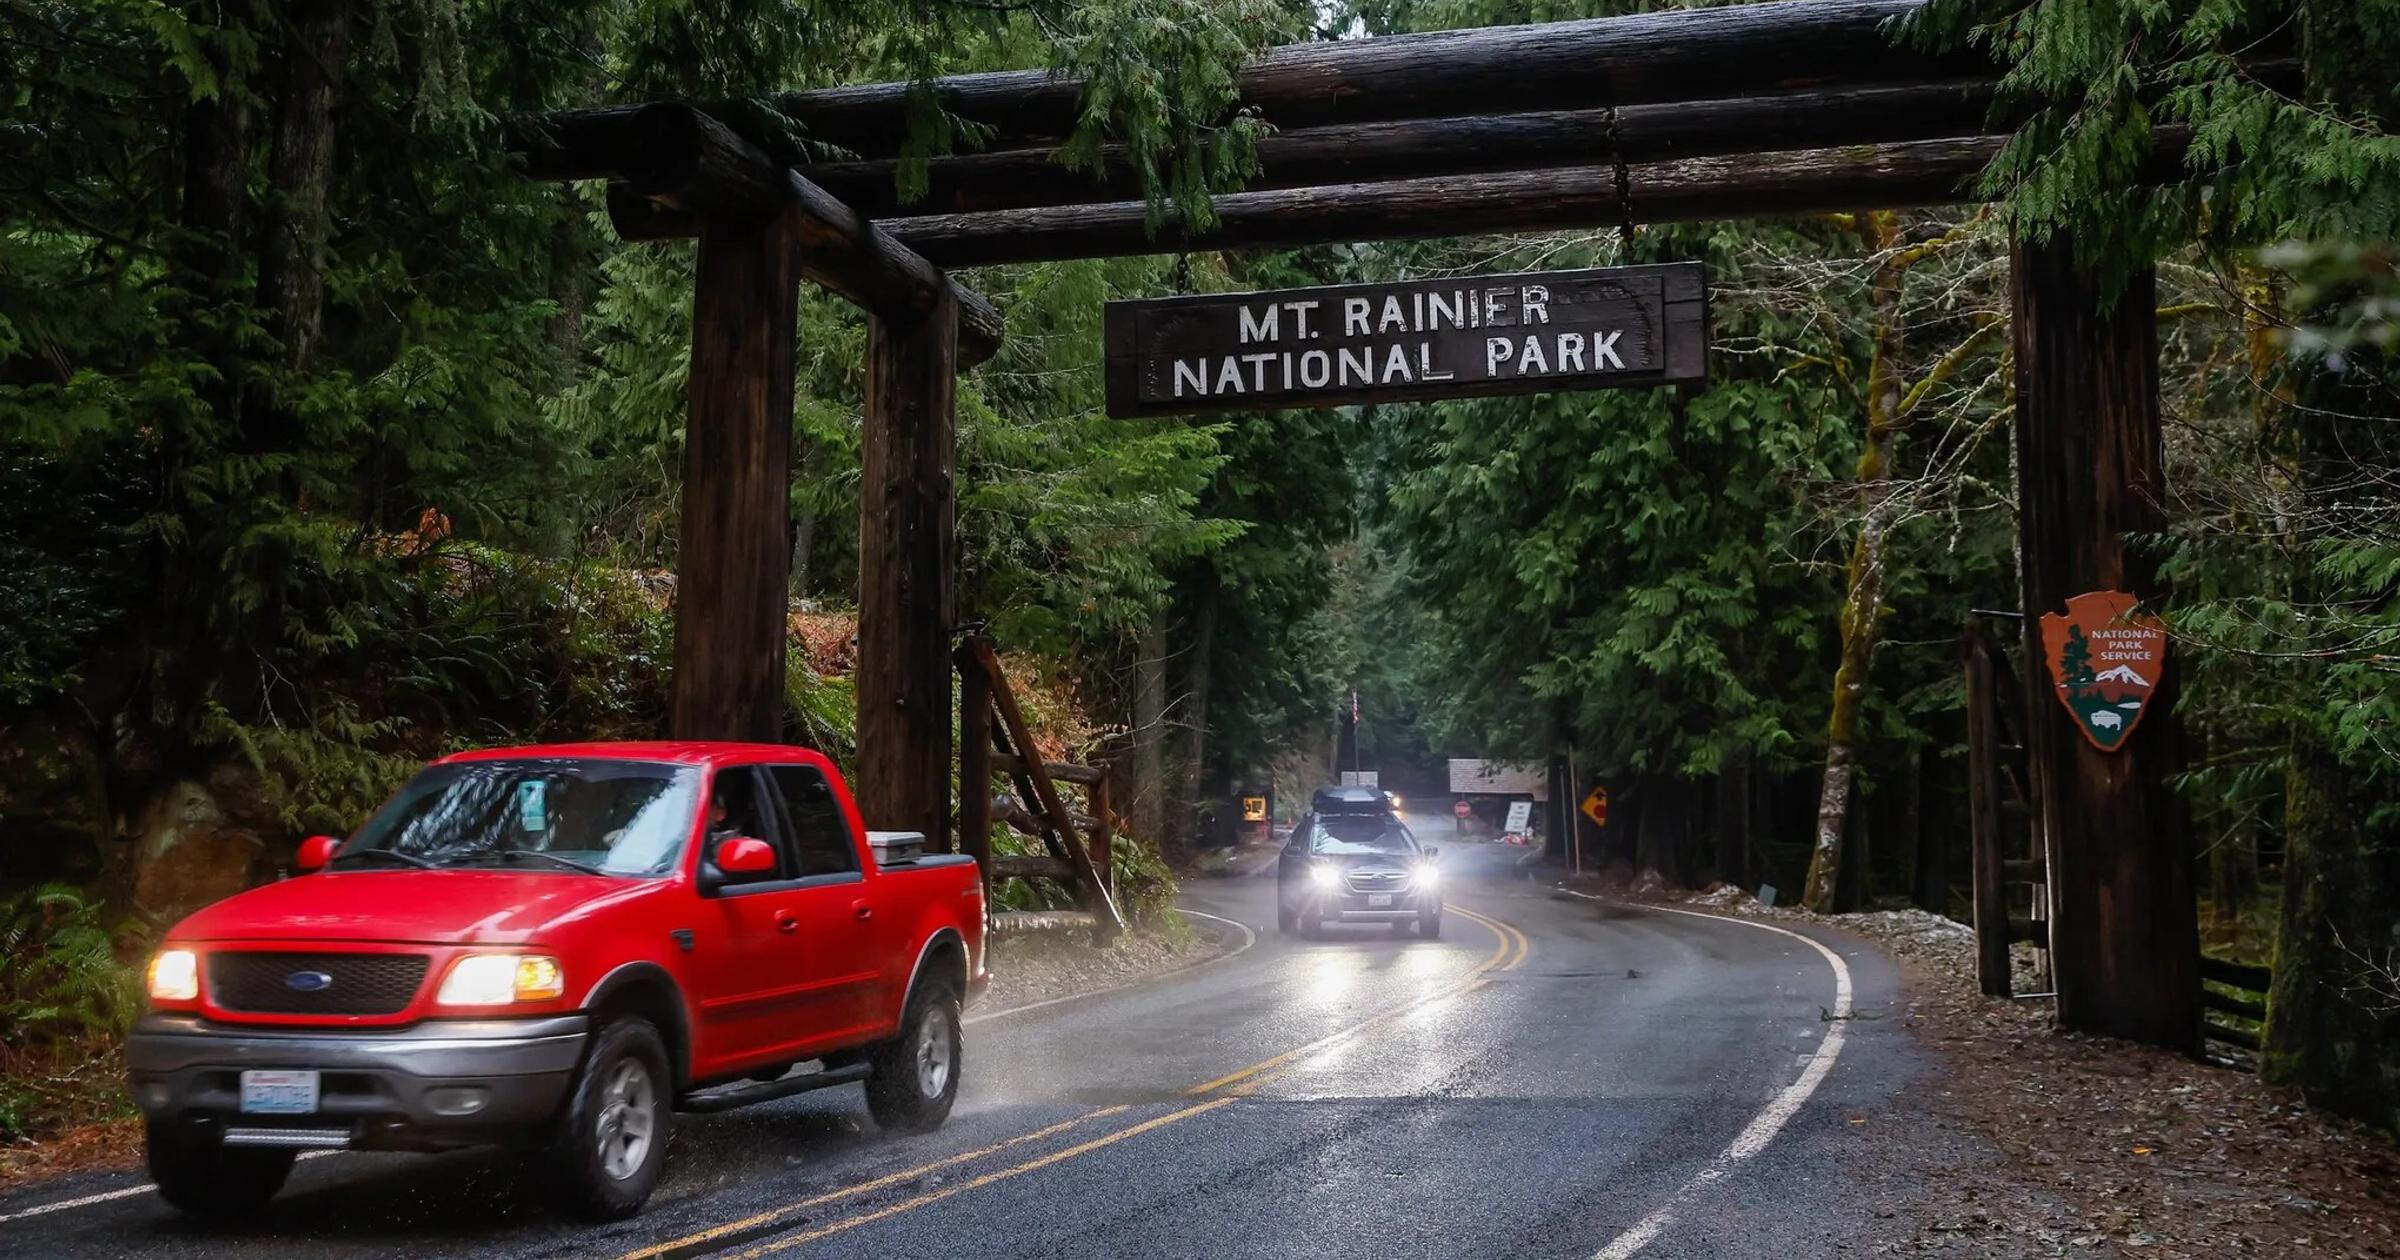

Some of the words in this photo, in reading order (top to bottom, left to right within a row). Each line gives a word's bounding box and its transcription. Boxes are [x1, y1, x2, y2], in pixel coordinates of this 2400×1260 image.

[1238, 300, 1319, 343] MT.
[1345, 284, 1549, 337] RAINIER
[1174, 342, 1454, 397] NATIONAL
[1487, 329, 1625, 377] PARK
[2092, 630, 2158, 639] NATIONAL
[2109, 641, 2143, 649] PARK
[2101, 651, 2151, 660] SERVICE
